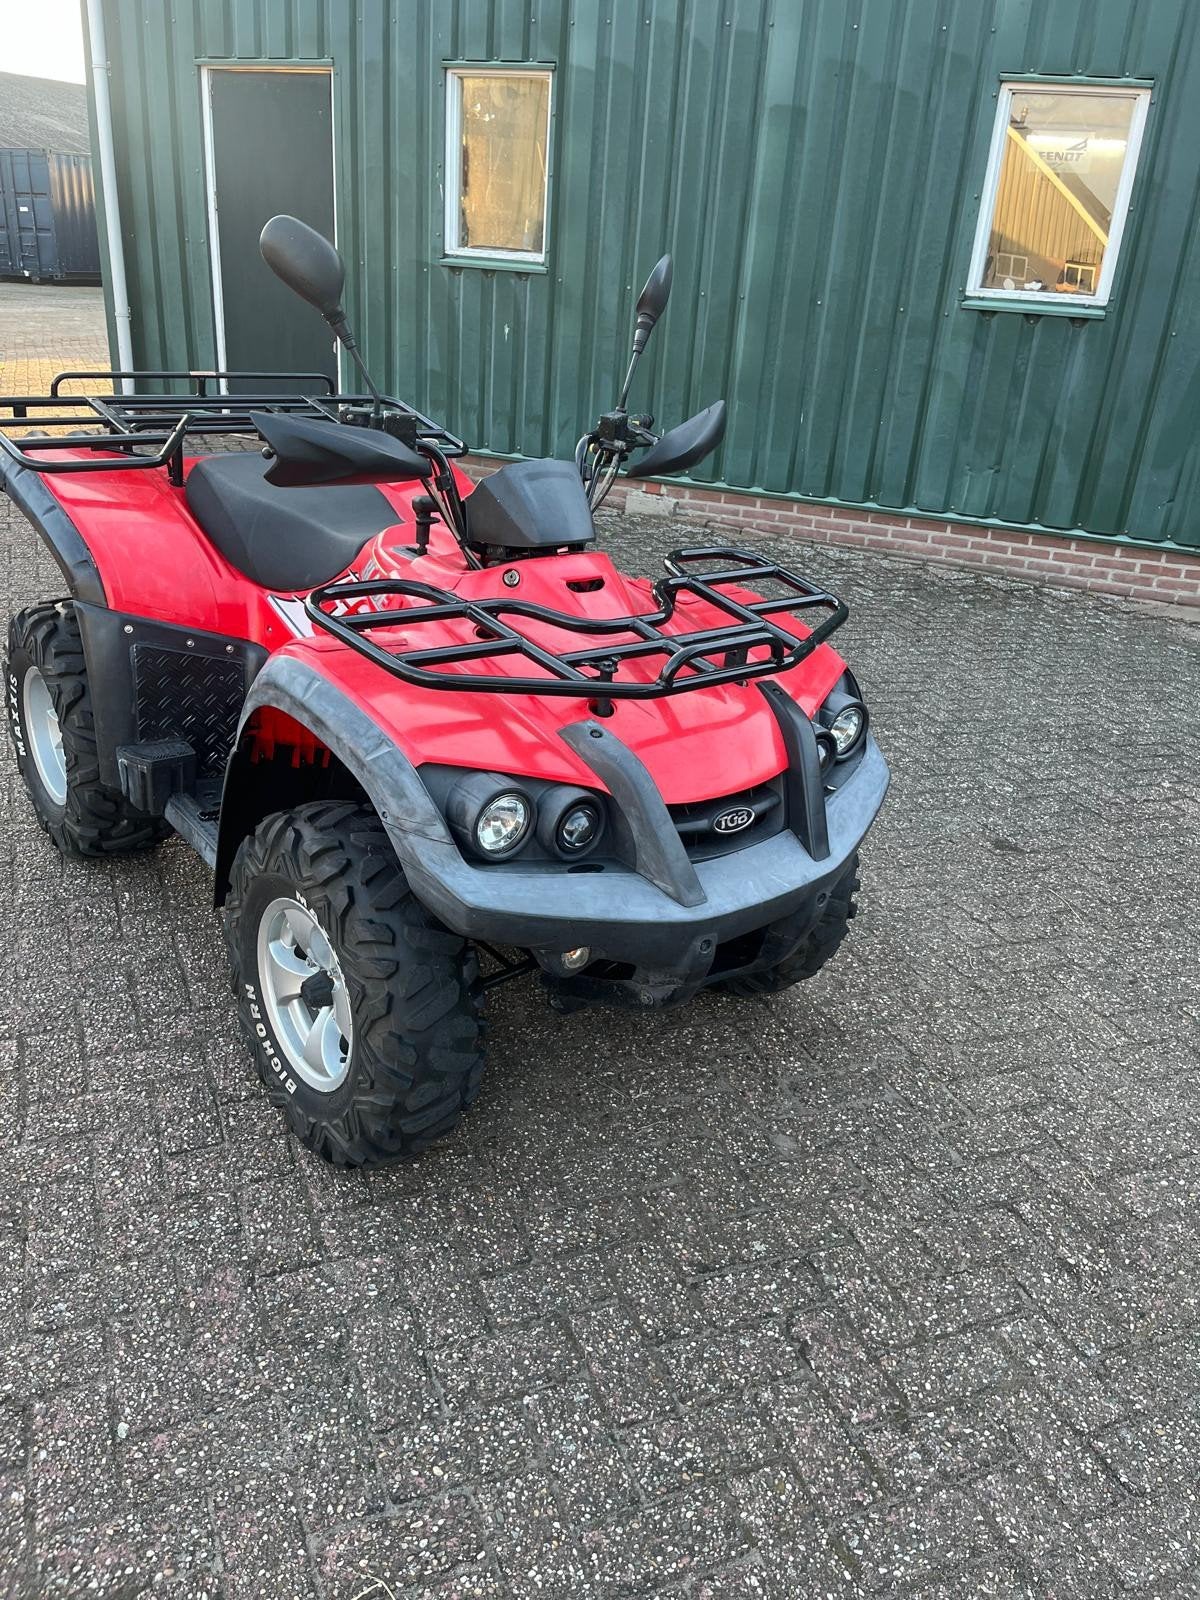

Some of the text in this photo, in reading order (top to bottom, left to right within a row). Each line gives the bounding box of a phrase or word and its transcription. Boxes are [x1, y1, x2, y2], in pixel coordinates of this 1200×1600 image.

[1038, 151, 1084, 162] FENDT
[9, 673, 27, 756] MAXXIS
[719, 810, 748, 830] TGB
[244, 983, 298, 1095] BIGHORN
